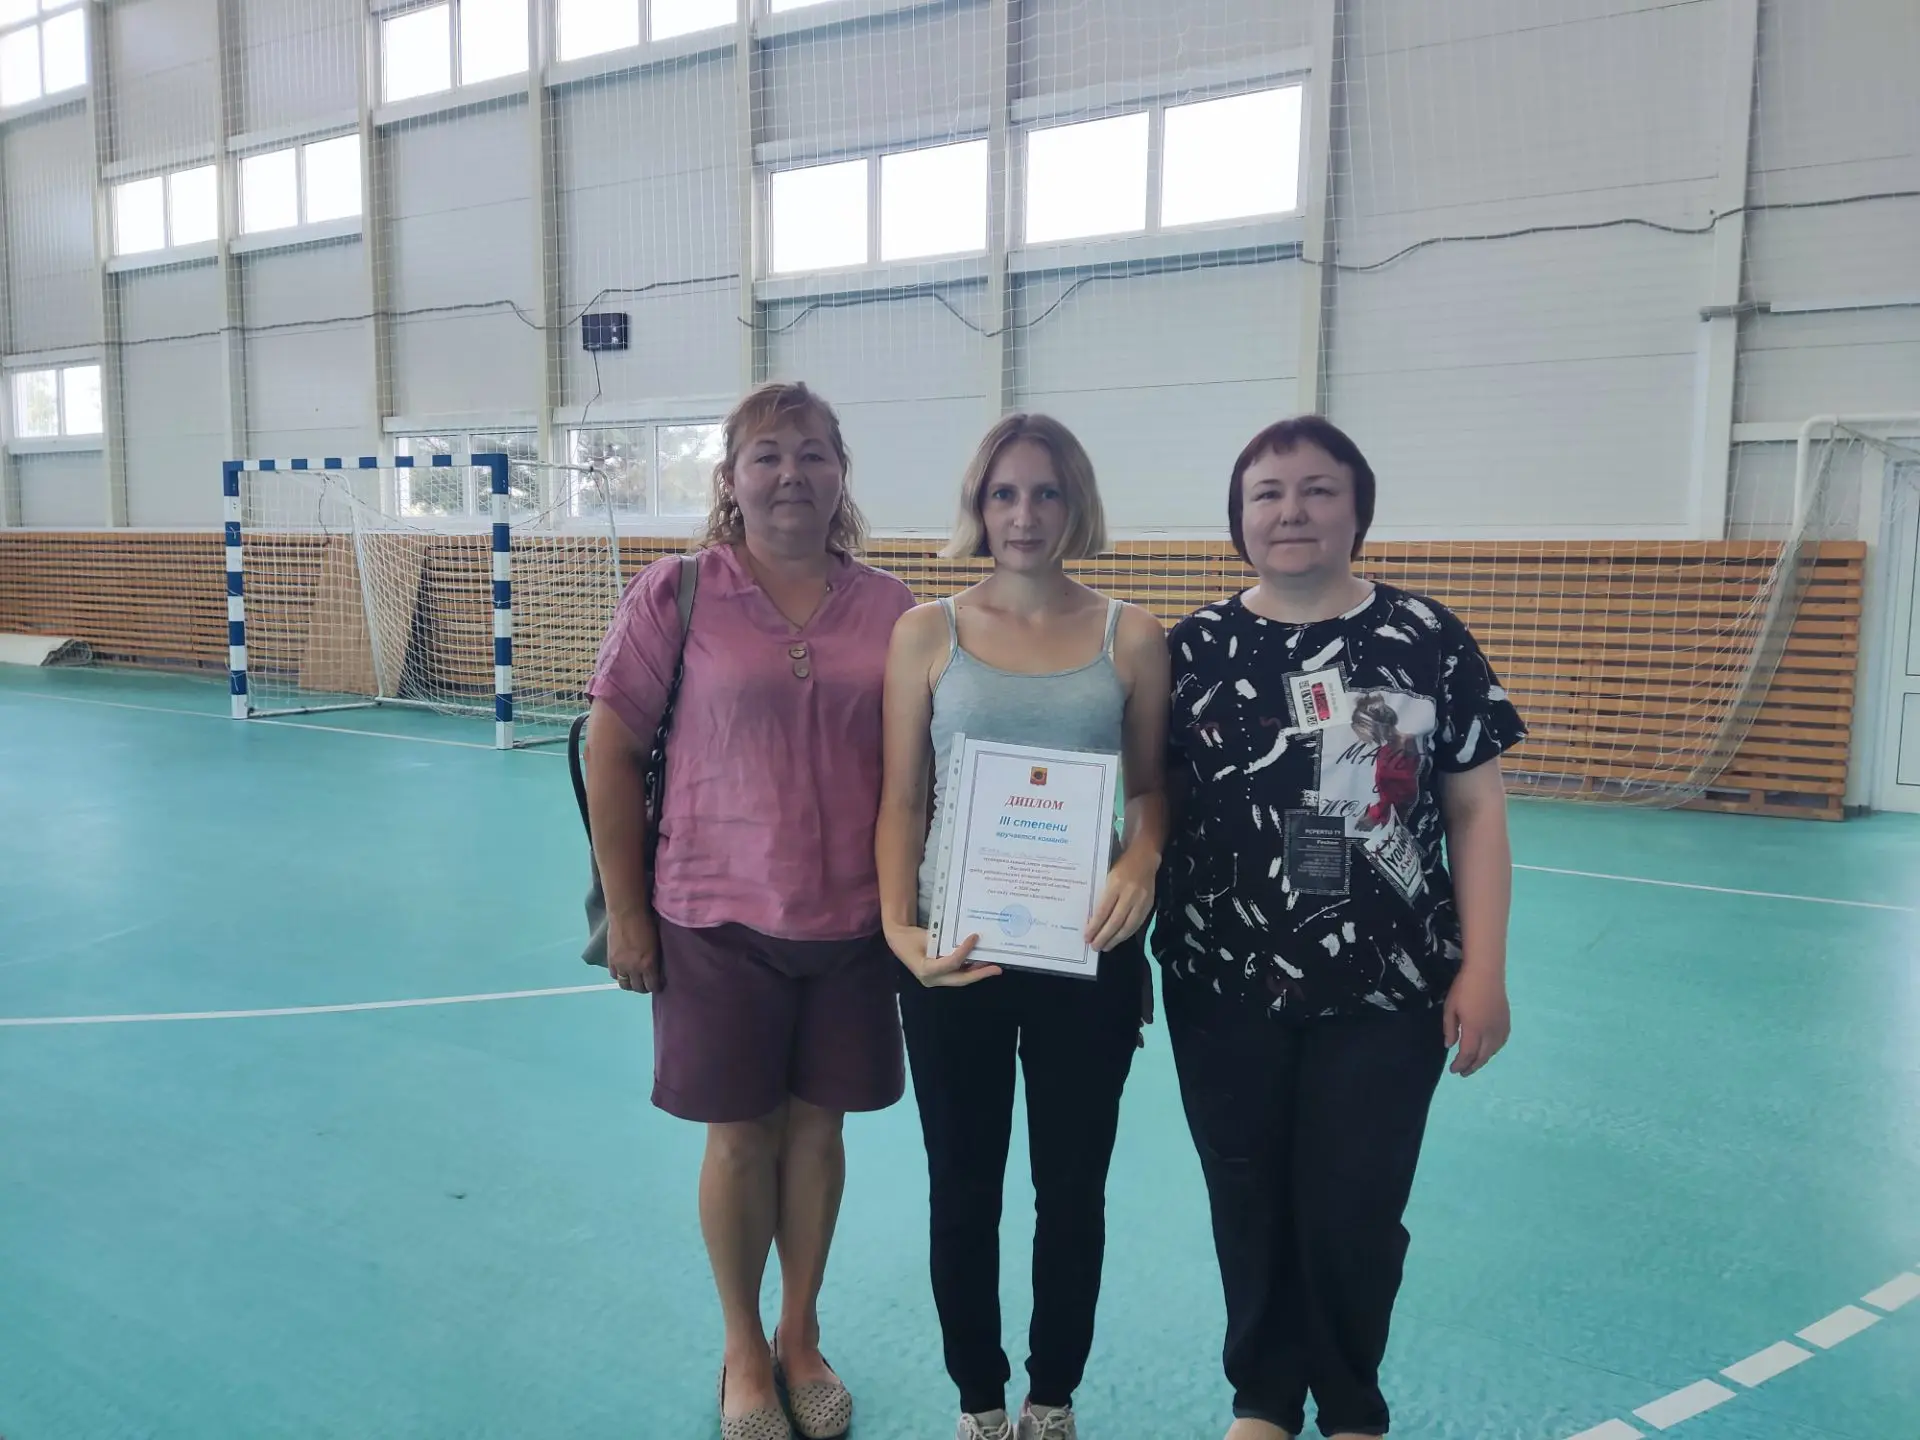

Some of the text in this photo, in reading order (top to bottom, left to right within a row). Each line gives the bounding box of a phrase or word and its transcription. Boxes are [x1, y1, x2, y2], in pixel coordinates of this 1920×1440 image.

[1004, 795, 1064, 811] ДИПЛОМ
[999, 815, 1068, 832] III степени
